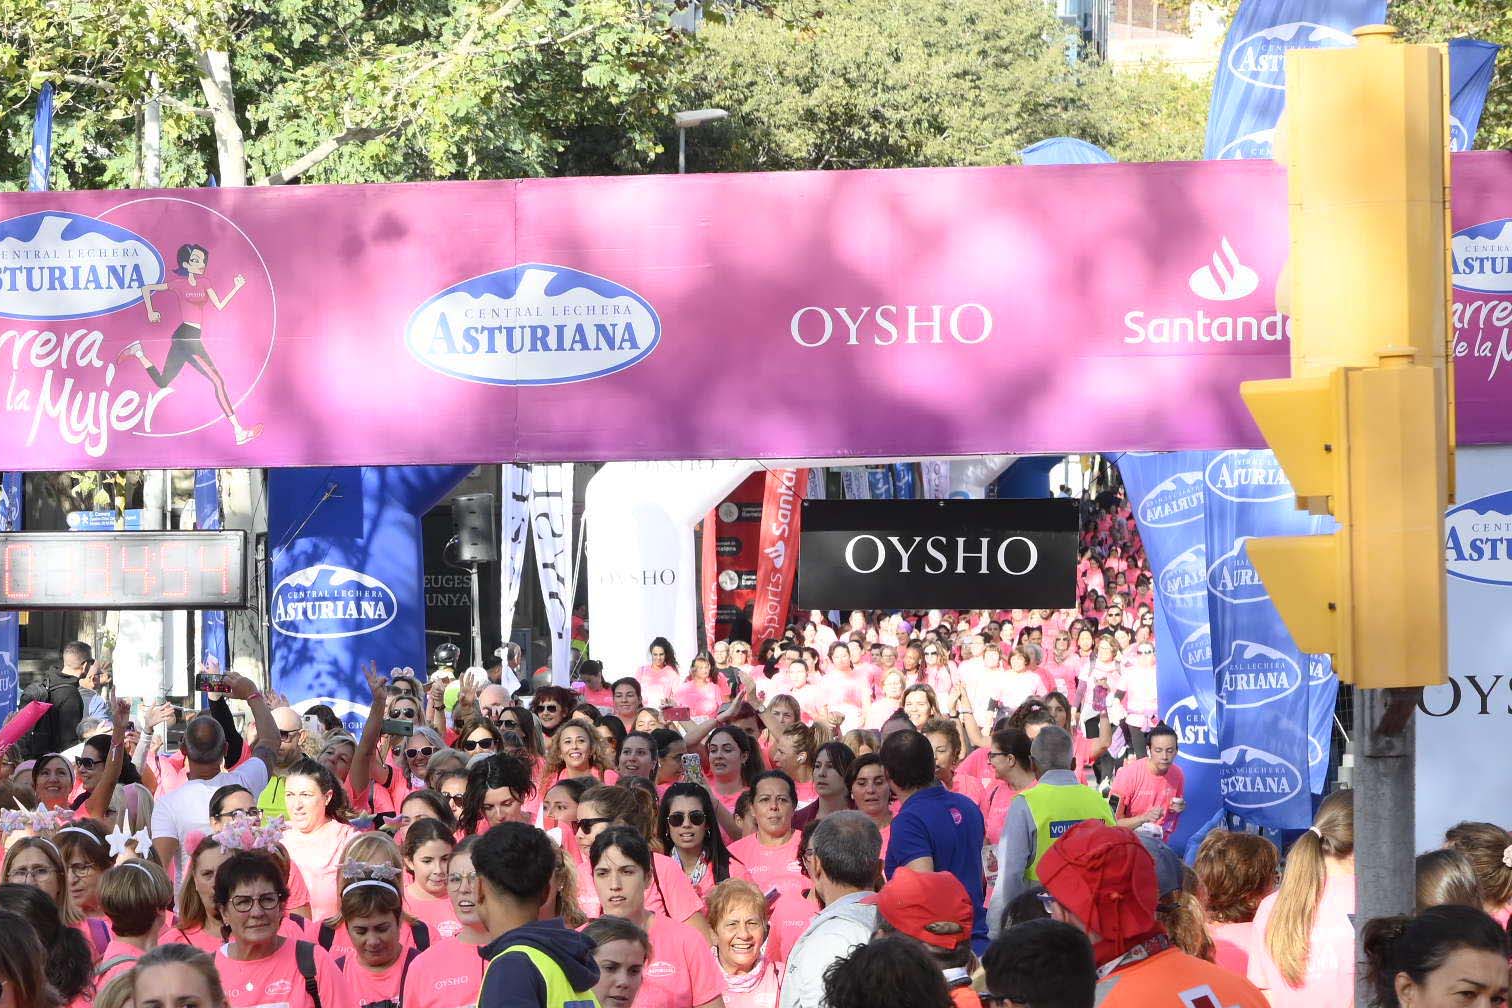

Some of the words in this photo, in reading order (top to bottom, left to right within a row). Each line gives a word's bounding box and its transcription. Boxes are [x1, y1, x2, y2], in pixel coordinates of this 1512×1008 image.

[66, 247, 140, 259] LECHERA
[464, 305, 545, 319] CENTRAL
[551, 304, 633, 317] LECHERA
[426, 311, 641, 359] ASTURIANA
[789, 302, 994, 348] OYSHO
[1474, 331, 1492, 357] la
[5, 373, 31, 411] la
[25, 362, 176, 458] Mujer
[844, 534, 1038, 575] OYSHO
[287, 589, 330, 599] CENTRAL
[332, 588, 383, 598] LECHERA
[274, 597, 389, 623] ASTURIANA
